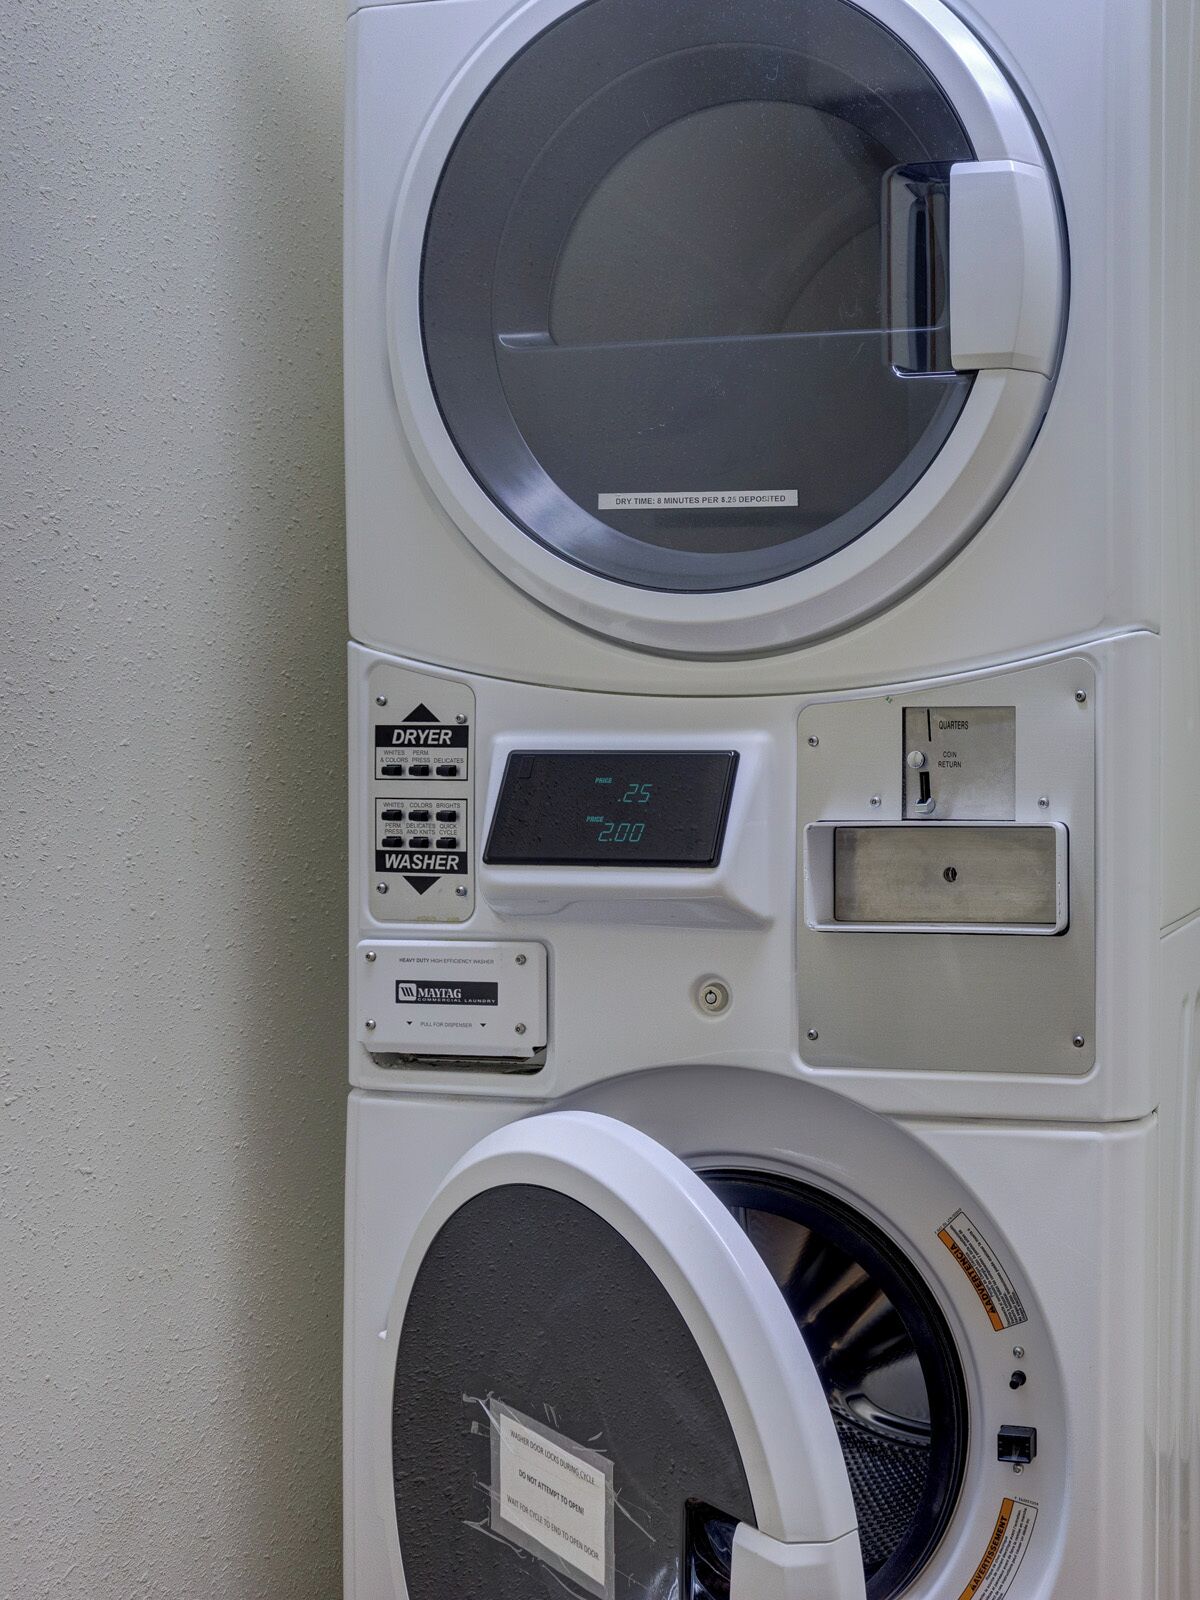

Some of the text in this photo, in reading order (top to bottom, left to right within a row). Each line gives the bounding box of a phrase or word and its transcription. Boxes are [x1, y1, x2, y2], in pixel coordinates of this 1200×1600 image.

[633, 497, 655, 505] TIME:
[664, 496, 700, 504] MINUTES
[938, 720, 969, 730] QUARTERS
[392, 729, 453, 745] DRYER
[617, 783, 653, 803] .25
[598, 822, 645, 842] 2.00
[385, 853, 460, 871] WASHER
[417, 988, 462, 999] MAYTAG
[950, 1242, 992, 1306] ADVERTENCIA
[510, 1430, 596, 1486] WASHER DOOR LOCKS DURING CYCLE
[518, 1469, 526, 1480] DO
[527, 1474, 537, 1486] NOT
[538, 1481, 560, 1501] ATTEMPT
[560, 1494, 568, 1505] TO
[506, 1494, 519, 1508] WAIT
[520, 1502, 529, 1514] FOR
[529, 1509, 543, 1524] CYCLE
[543, 1518, 551, 1529] TO
[551, 1523, 561, 1536] END
[561, 1529, 569, 1541] TO
[569, 1535, 584, 1550] OPEN
[975, 1515, 1008, 1587] AVERTISSEMENT
